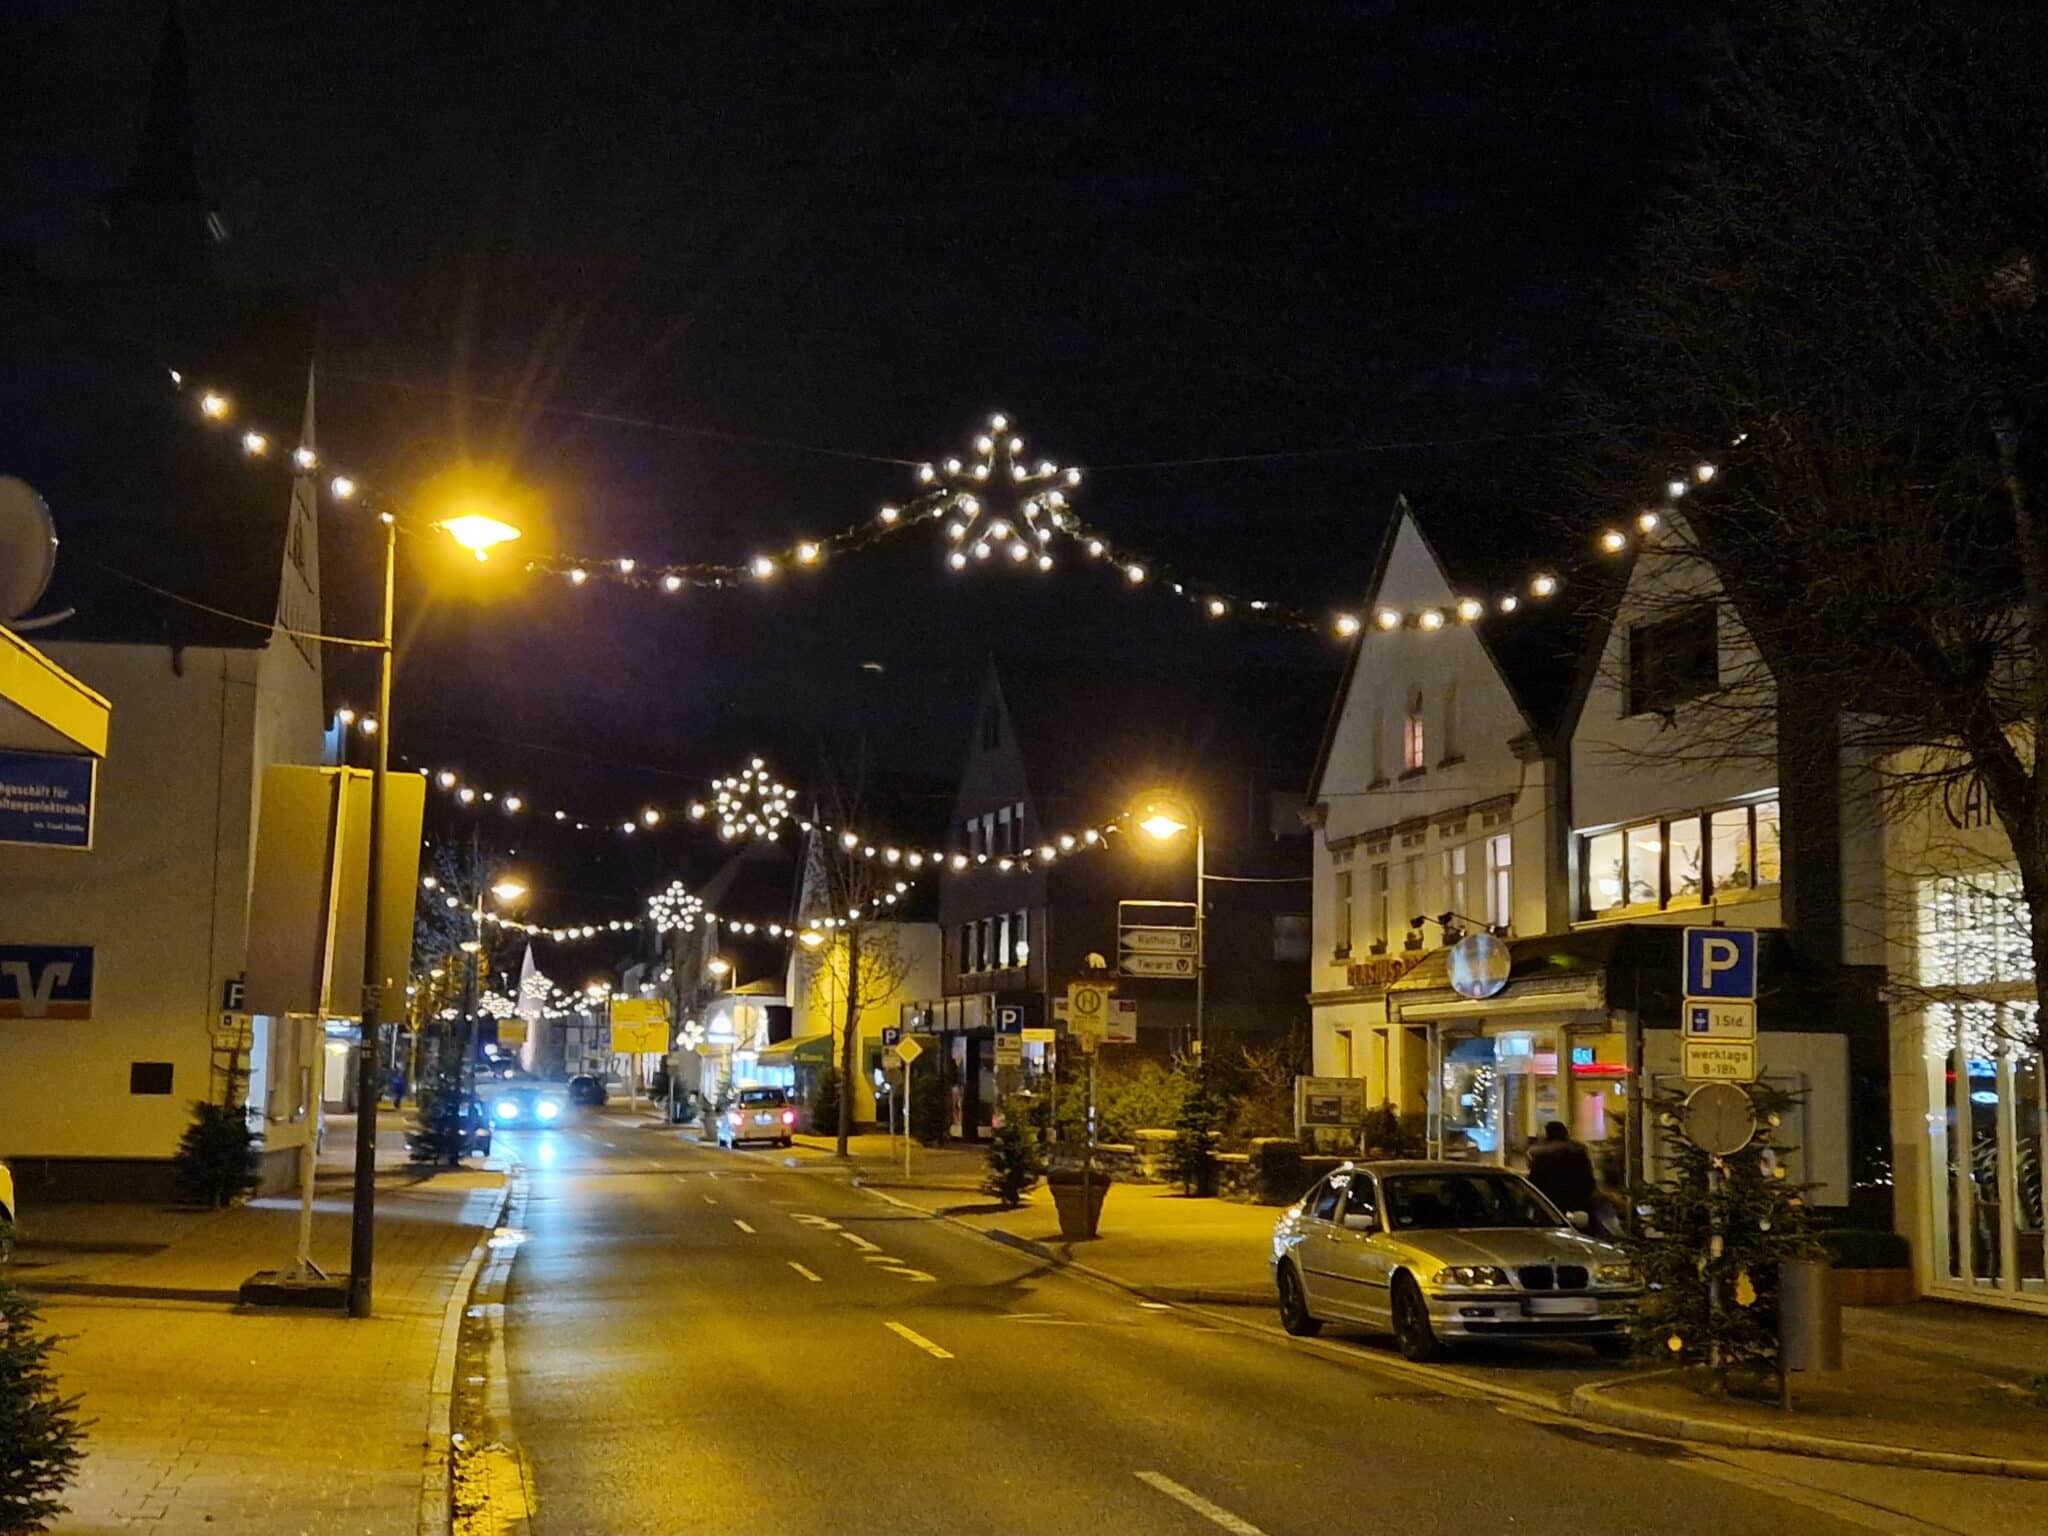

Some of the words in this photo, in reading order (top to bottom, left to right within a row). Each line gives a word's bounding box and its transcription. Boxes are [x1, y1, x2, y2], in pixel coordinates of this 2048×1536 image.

[1138, 935, 1176, 945] Rathaus
[1702, 938, 1740, 989] P
[1001, 1009, 1017, 1031] P
[1714, 1015, 1720, 1027] 1
[885, 1029, 897, 1045] P
[1690, 1050, 1749, 1063] werktags
